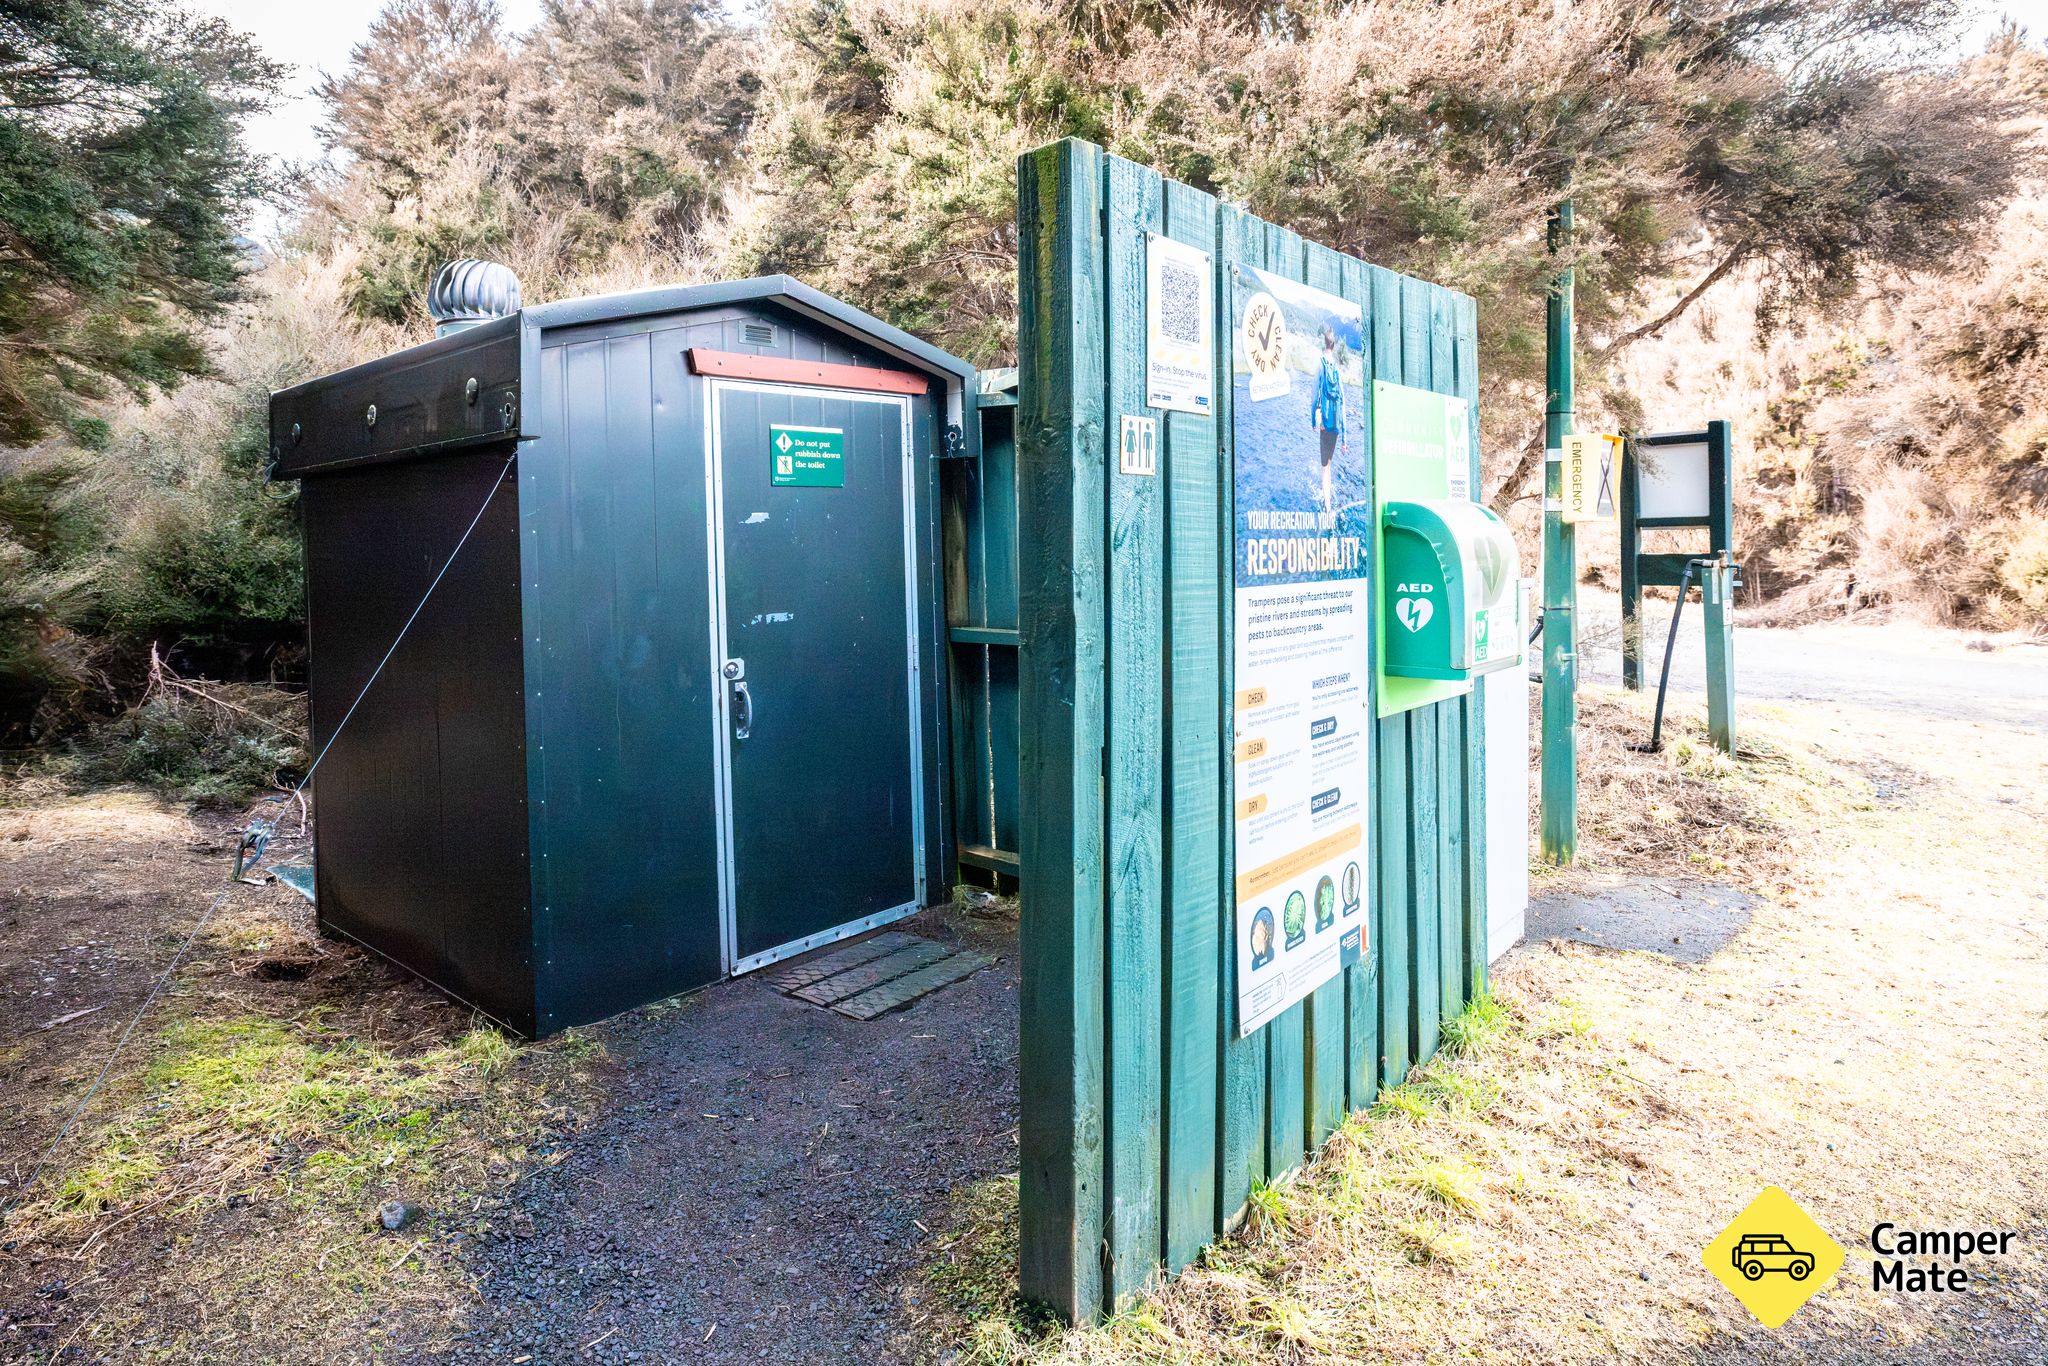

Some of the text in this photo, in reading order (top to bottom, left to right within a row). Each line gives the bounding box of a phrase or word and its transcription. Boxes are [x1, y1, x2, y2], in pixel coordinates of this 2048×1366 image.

[1248, 304, 1268, 338] CHECK
[1270, 326, 1282, 372] CLEAN
[1250, 350, 1266, 373] DRY
[795, 450, 821, 458] rubbish
[1450, 445, 1466, 462] AED
[1572, 442, 1582, 513] EMERGENCY
[1248, 511, 1336, 532] YOUR RECREATION, YOUR
[1247, 537, 1360, 576] RESPONSIBILITY
[1396, 583, 1433, 593] AED
[1248, 597, 1276, 609] Trampers
[1277, 596, 1290, 607] pose
[1295, 592, 1322, 605] significant
[1323, 590, 1338, 600] threat
[1345, 590, 1353, 598] our
[1248, 603, 1353, 627] pristine rivers and streams by spreading
[1248, 623, 1324, 643] pests to backcountry areas.
[1475, 647, 1487, 659] AED
[1248, 692, 1264, 704] CHECK
[1248, 742, 1263, 755] CLEAN
[1249, 800, 1258, 813] DRY
